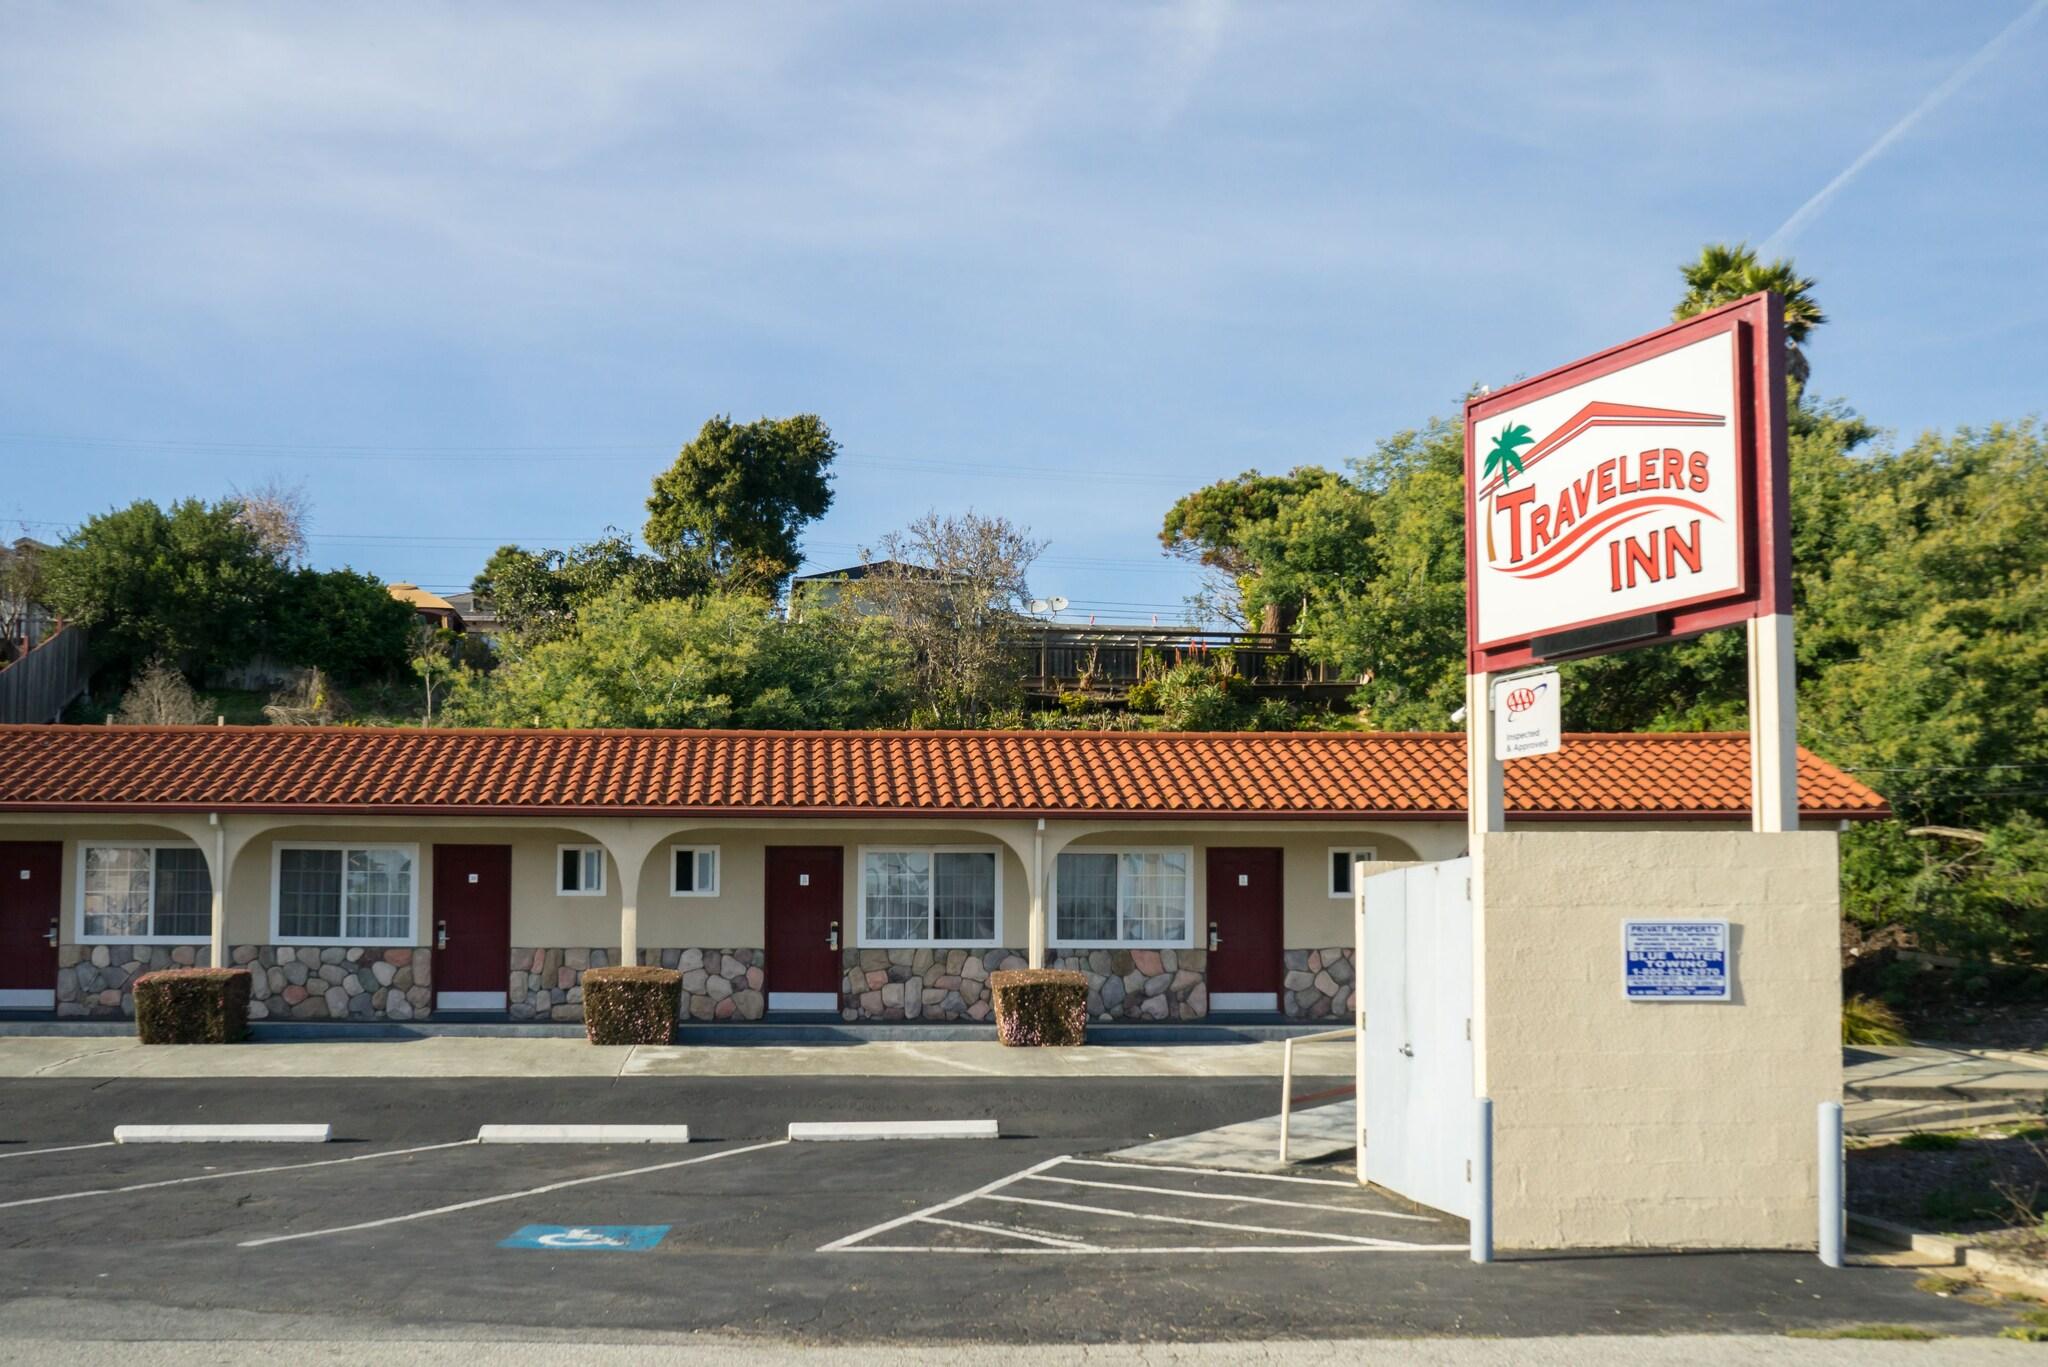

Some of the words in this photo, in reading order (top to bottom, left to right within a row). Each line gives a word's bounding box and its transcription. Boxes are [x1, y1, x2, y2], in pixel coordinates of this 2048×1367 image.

[1496, 448, 1709, 563] TRAVELERS
[1609, 519, 1701, 592] INN
[1508, 689, 1534, 711] AAA
[1514, 738, 1549, 752] Approved
[1629, 951, 1667, 960] BLUE
[1672, 951, 1722, 961] WATER
[1647, 960, 1708, 968] TOWING
